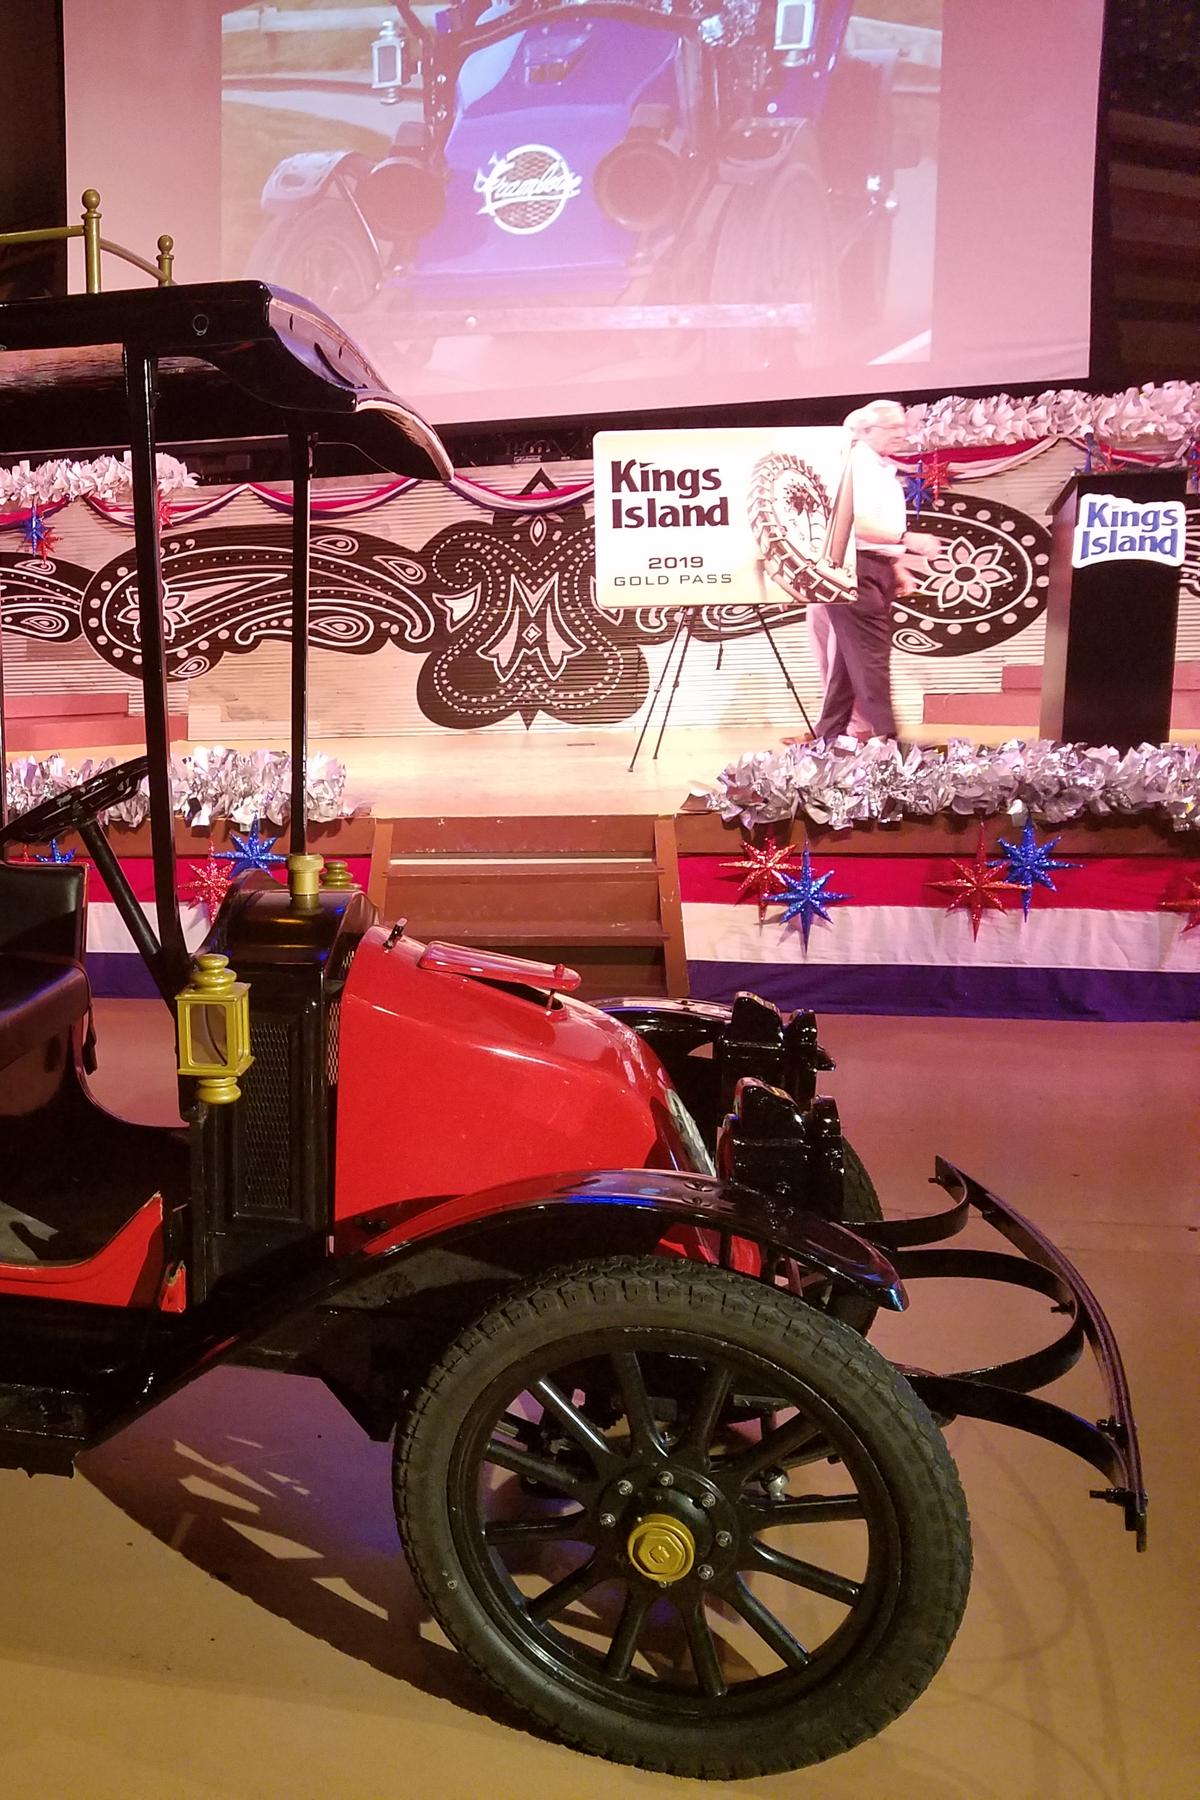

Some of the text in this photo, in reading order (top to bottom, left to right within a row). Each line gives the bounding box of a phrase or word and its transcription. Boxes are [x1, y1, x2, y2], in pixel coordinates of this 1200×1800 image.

[611, 459, 722, 498] Kings
[611, 497, 730, 529] Island
[1087, 502, 1178, 532] Kings
[1080, 529, 1178, 560] Island
[648, 556, 704, 570] 2019
[614, 573, 732, 587] GOLD PASS
